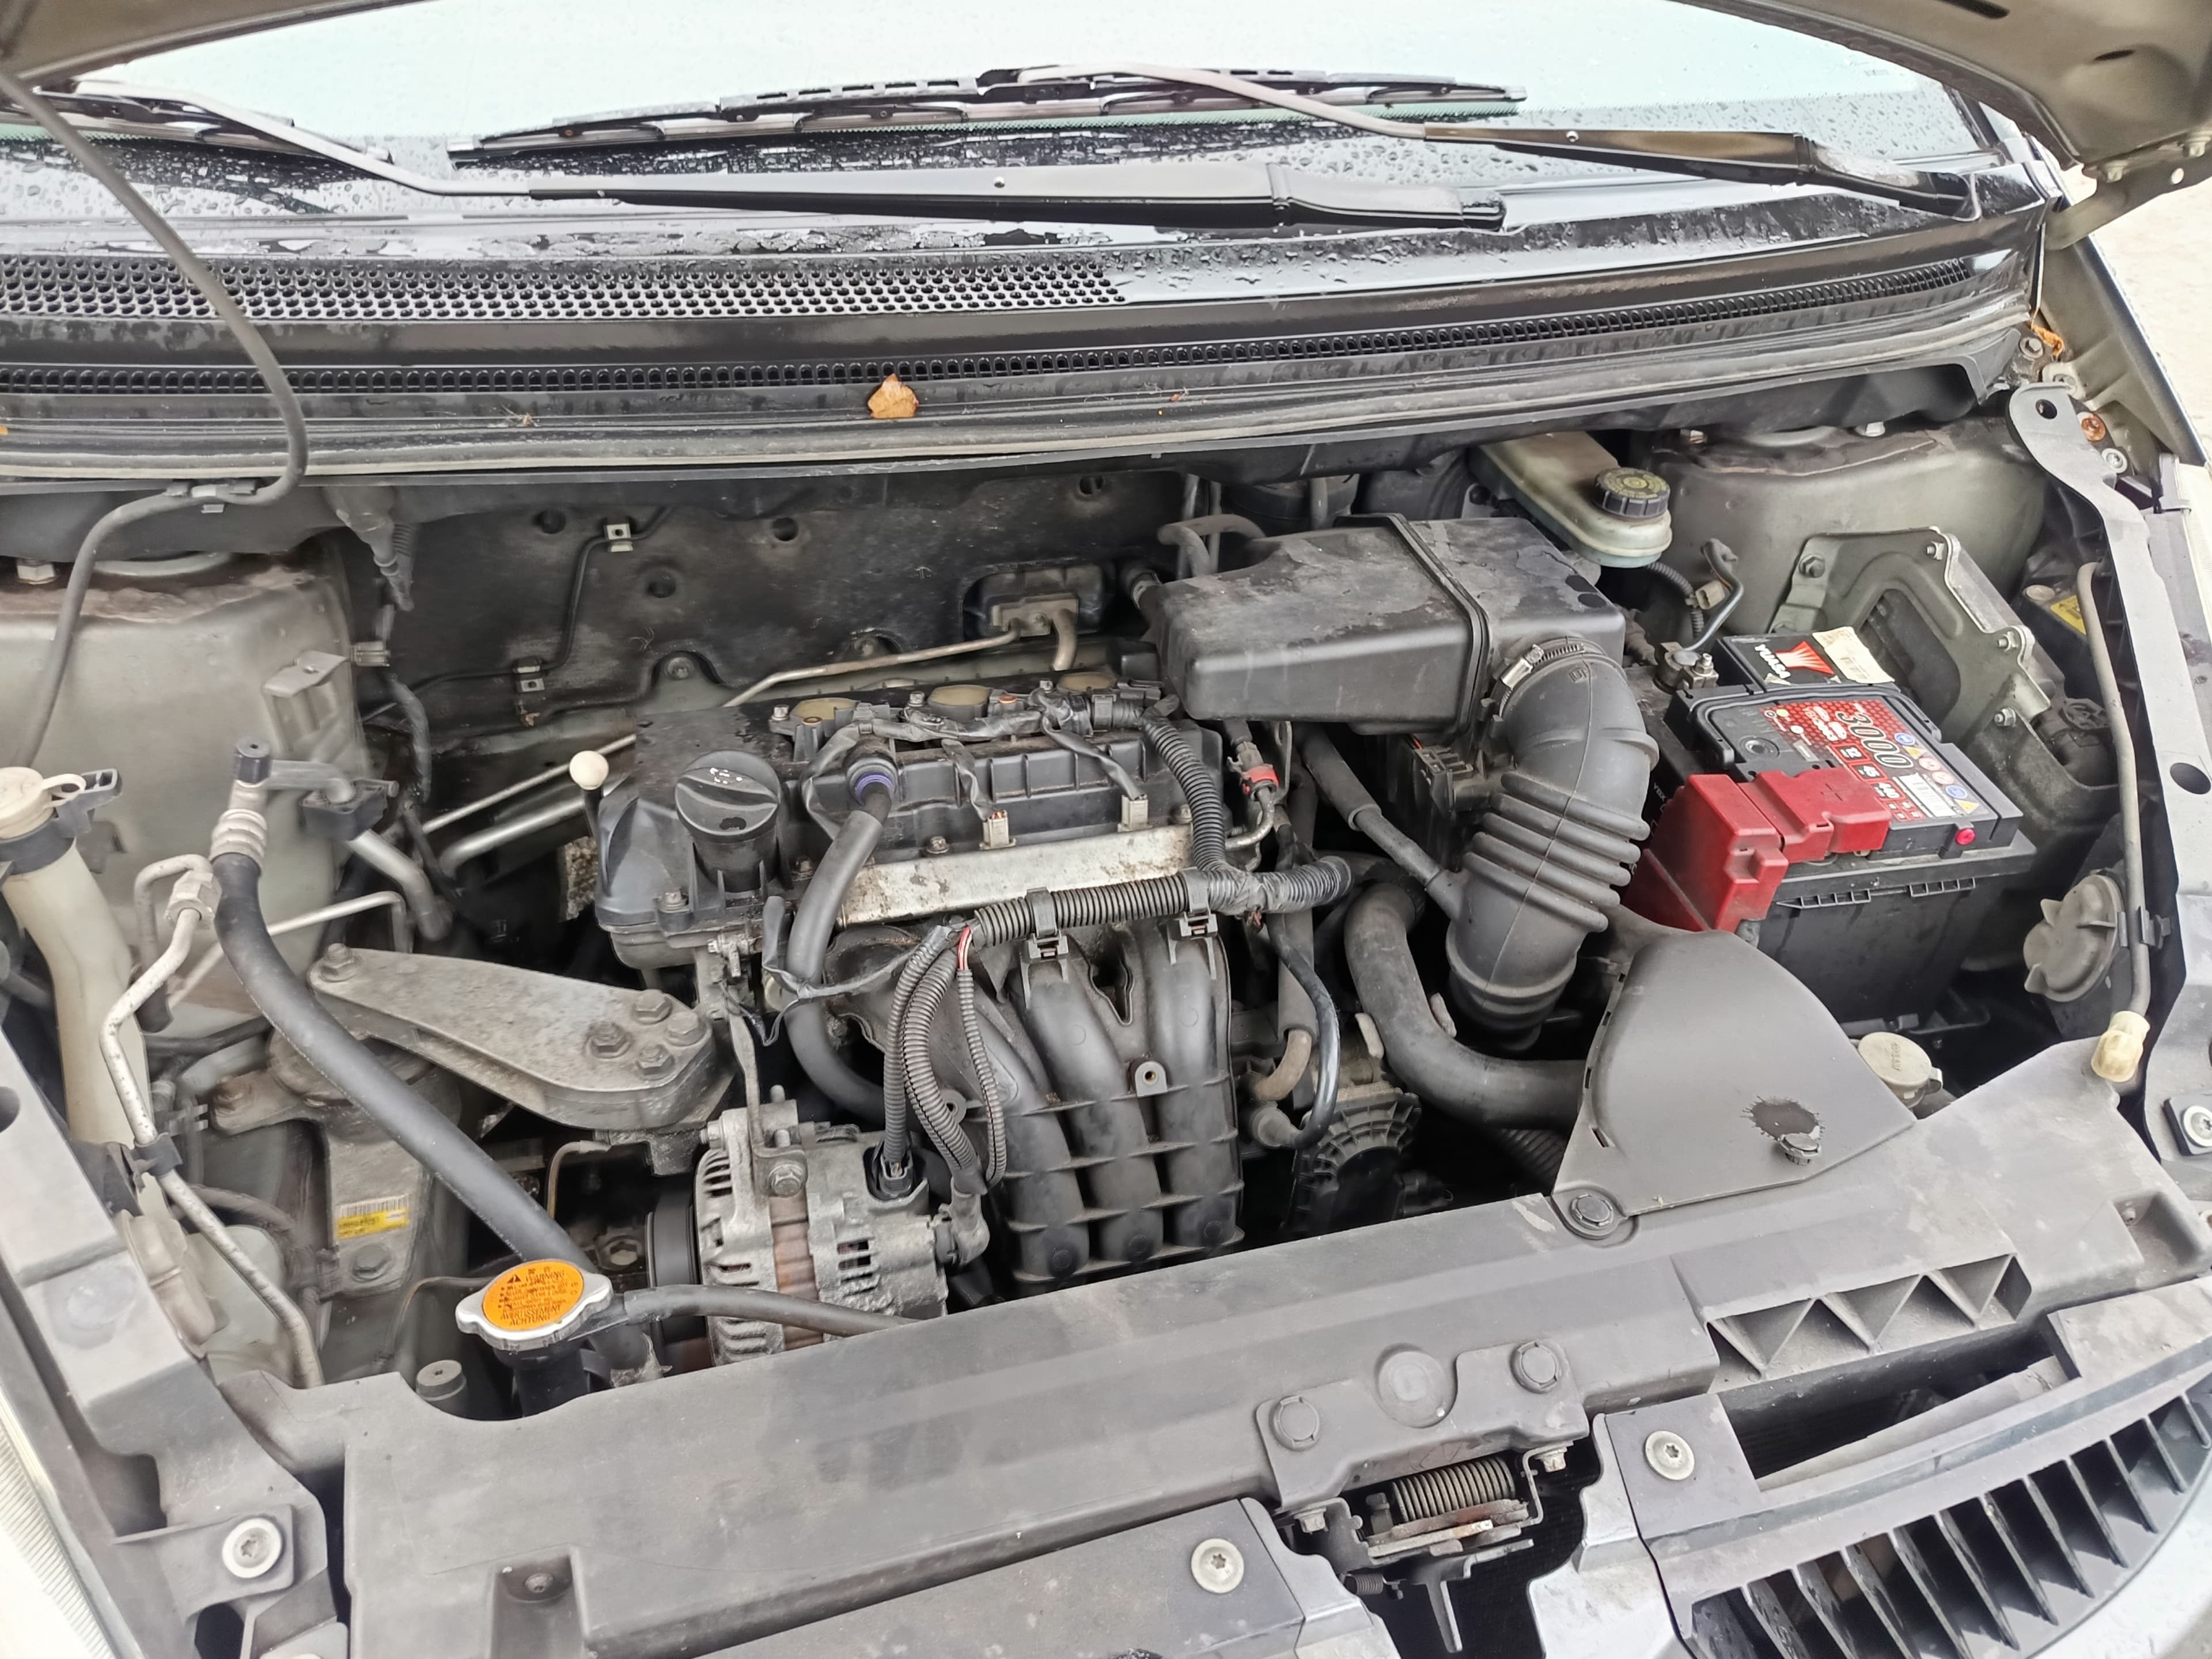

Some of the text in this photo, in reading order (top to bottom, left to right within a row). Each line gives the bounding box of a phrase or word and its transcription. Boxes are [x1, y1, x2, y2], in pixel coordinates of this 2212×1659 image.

[1754, 643, 1791, 679] YUASA
[1835, 710, 1914, 769] 3000
[525, 1270, 565, 1283] WARNING
